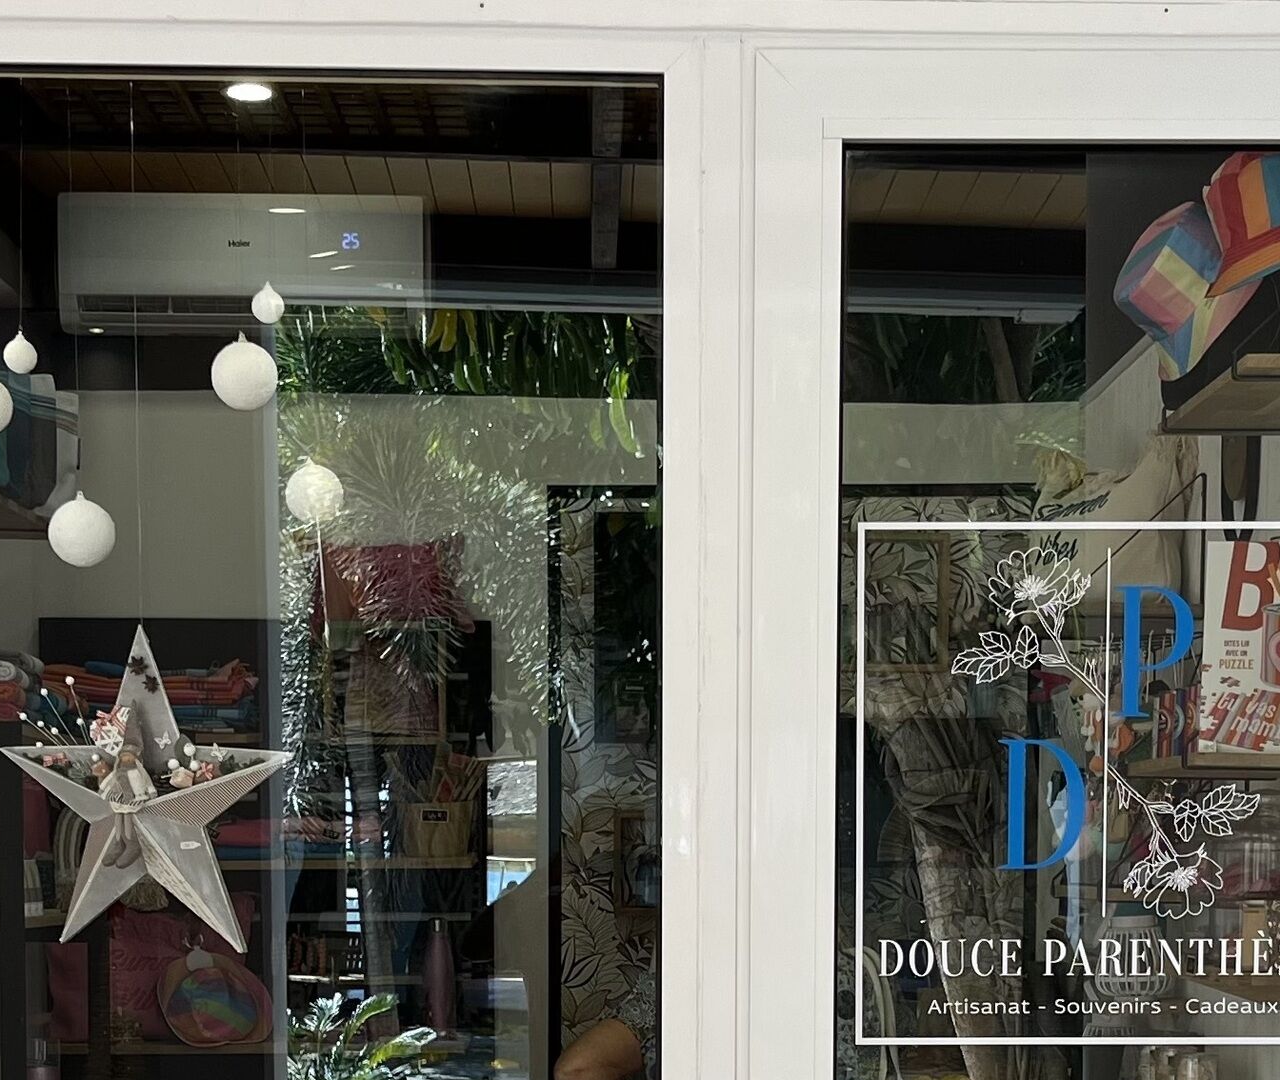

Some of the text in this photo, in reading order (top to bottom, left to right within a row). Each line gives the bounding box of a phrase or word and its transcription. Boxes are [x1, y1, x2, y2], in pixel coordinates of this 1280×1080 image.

[228, 240, 251, 248] Haier
[341, 232, 360, 250] 25
[1115, 584, 1194, 719] P
[1219, 659, 1254, 670] PUZZLE
[998, 738, 1086, 870] D
[878, 938, 1023, 977] DOUCE
[927, 997, 1031, 1015] Artisanat
[1053, 997, 1162, 1015] Souvenirs
[1185, 996, 1279, 1015] Cadeaux
